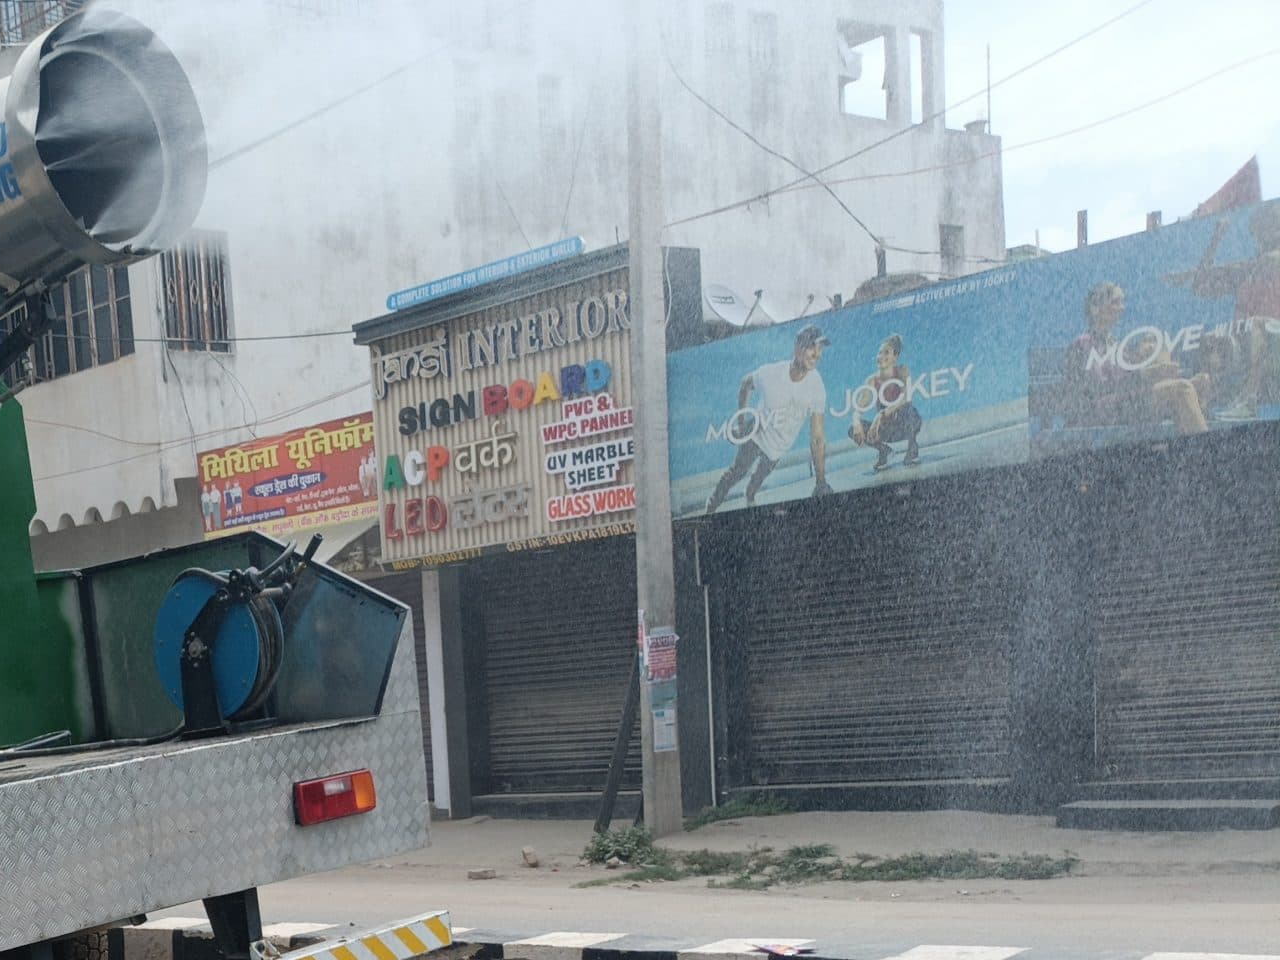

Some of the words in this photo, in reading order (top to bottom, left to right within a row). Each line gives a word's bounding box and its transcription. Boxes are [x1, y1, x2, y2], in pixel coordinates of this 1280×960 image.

[397, 287, 430, 306] COMPLETE
[430, 276, 463, 296] SOLUTION
[463, 271, 477, 288] FOR
[982, 270, 1018, 288] JOCKEY
[455, 289, 631, 372] INTERIOR
[1085, 325, 1204, 371] MOVE
[399, 393, 476, 437] SIGN
[483, 359, 612, 417] BOARD
[565, 398, 594, 419] PVC
[597, 395, 611, 411] &
[705, 406, 786, 446] MOVE
[829, 363, 974, 418] JOCKEY
[543, 420, 578, 442] WPC
[201, 444, 279, 482] मिथिला
[383, 446, 451, 491] ACP
[454, 420, 517, 474] वर्क
[547, 453, 567, 471] UV
[572, 440, 634, 466] MARBLE
[287, 473, 299, 488] की
[568, 463, 615, 486] SHEET
[384, 496, 448, 541] LED
[548, 495, 592, 520] GLASS
[592, 487, 637, 513] WORK
